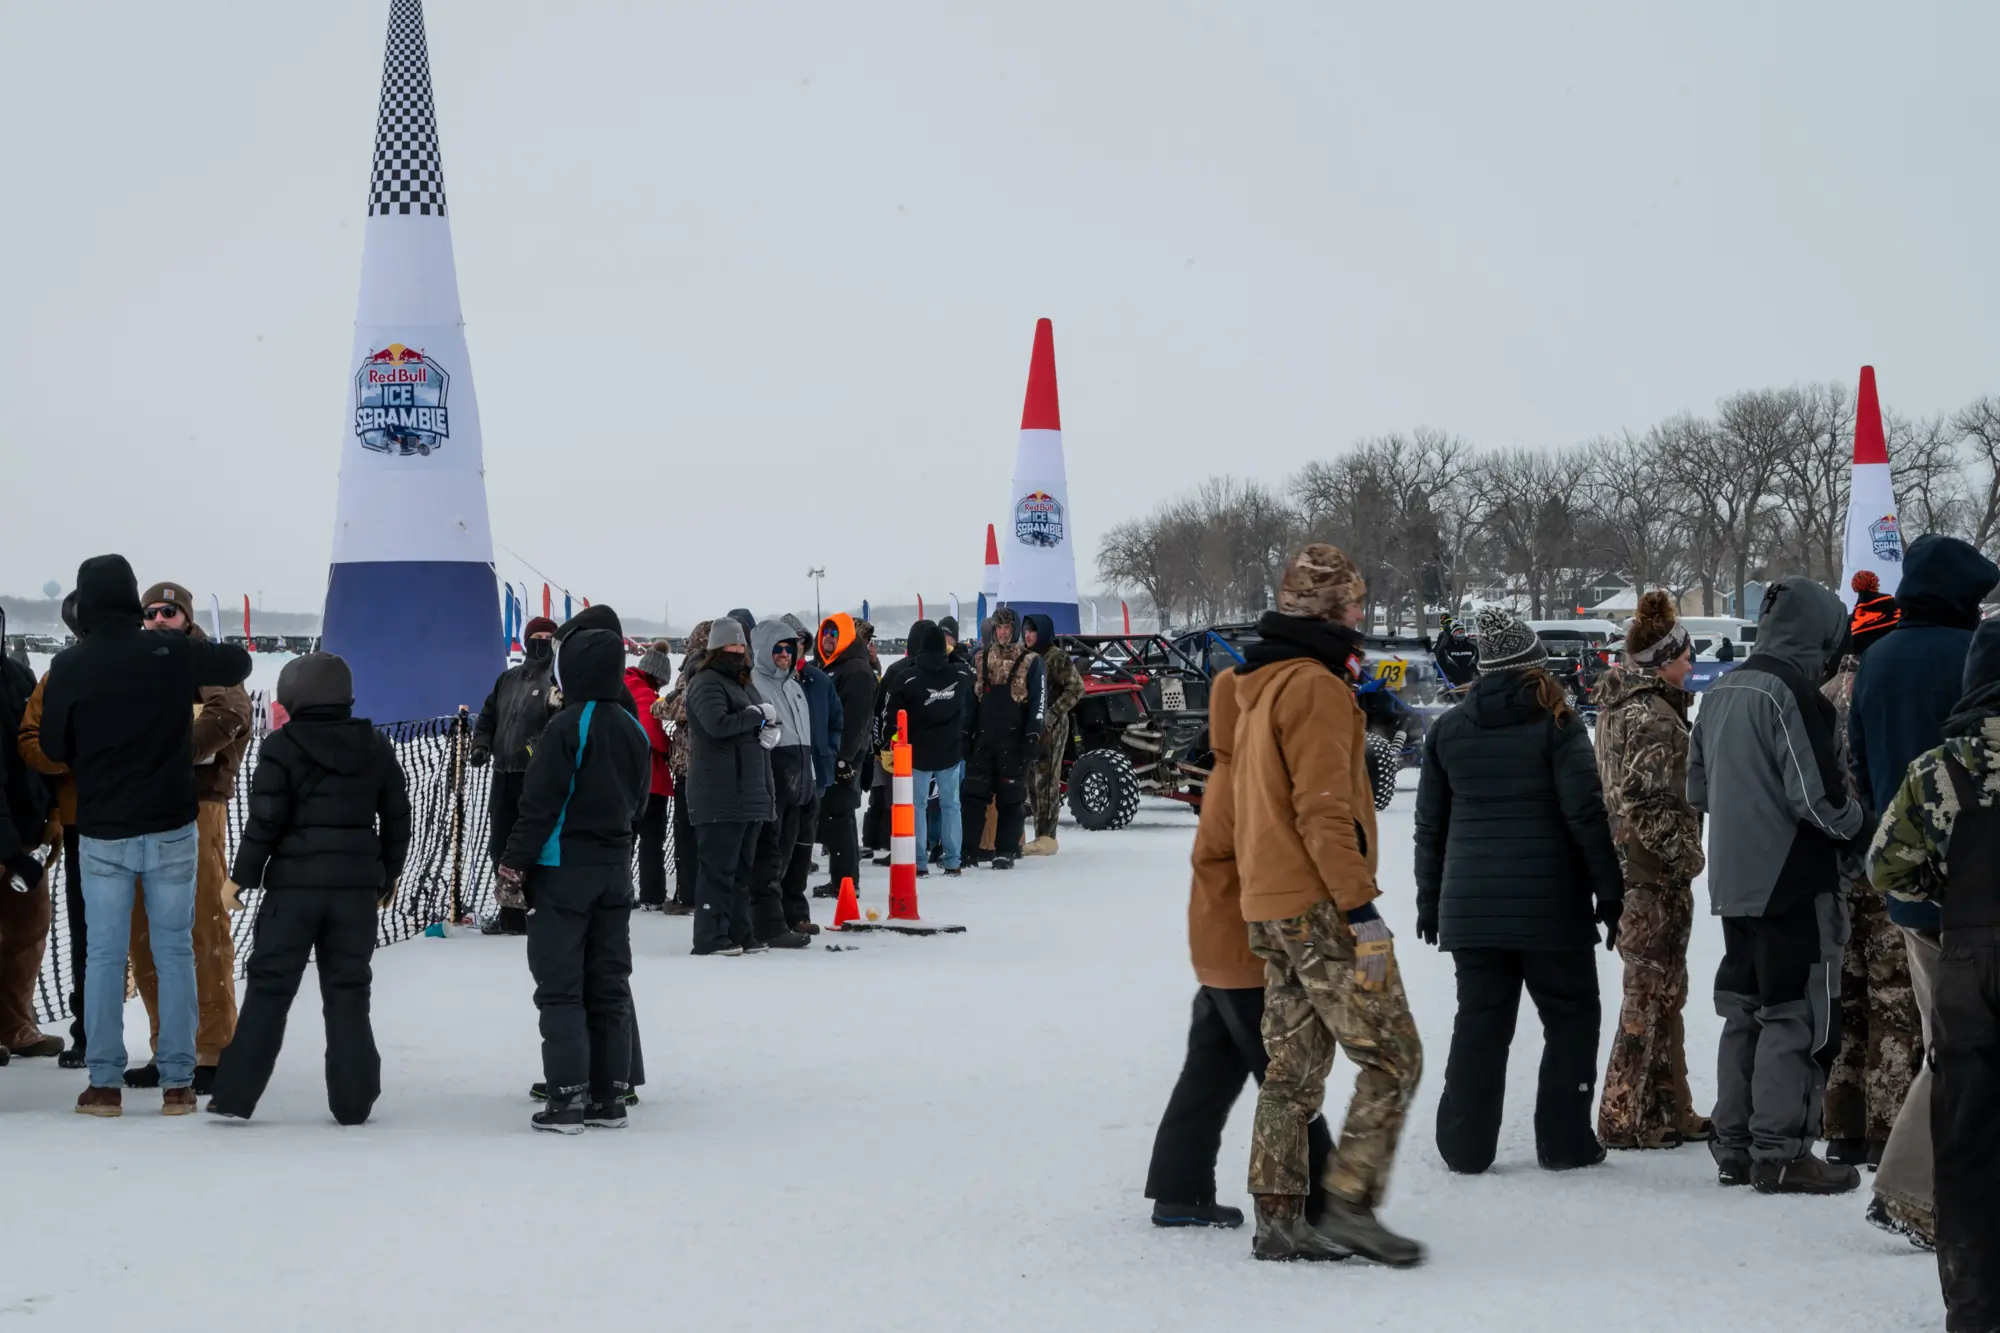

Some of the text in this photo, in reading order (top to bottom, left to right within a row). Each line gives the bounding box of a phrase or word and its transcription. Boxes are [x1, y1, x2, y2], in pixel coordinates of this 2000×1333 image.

[369, 367, 427, 382] Red Bull
[383, 386, 412, 405] ICE
[356, 407, 448, 437] SCRAMBLE
[1025, 503, 1054, 511] Red Bull
[1032, 512, 1047, 522] ICE
[1017, 522, 1062, 538] SCRAMBLE
[1381, 665, 1401, 682] 03
